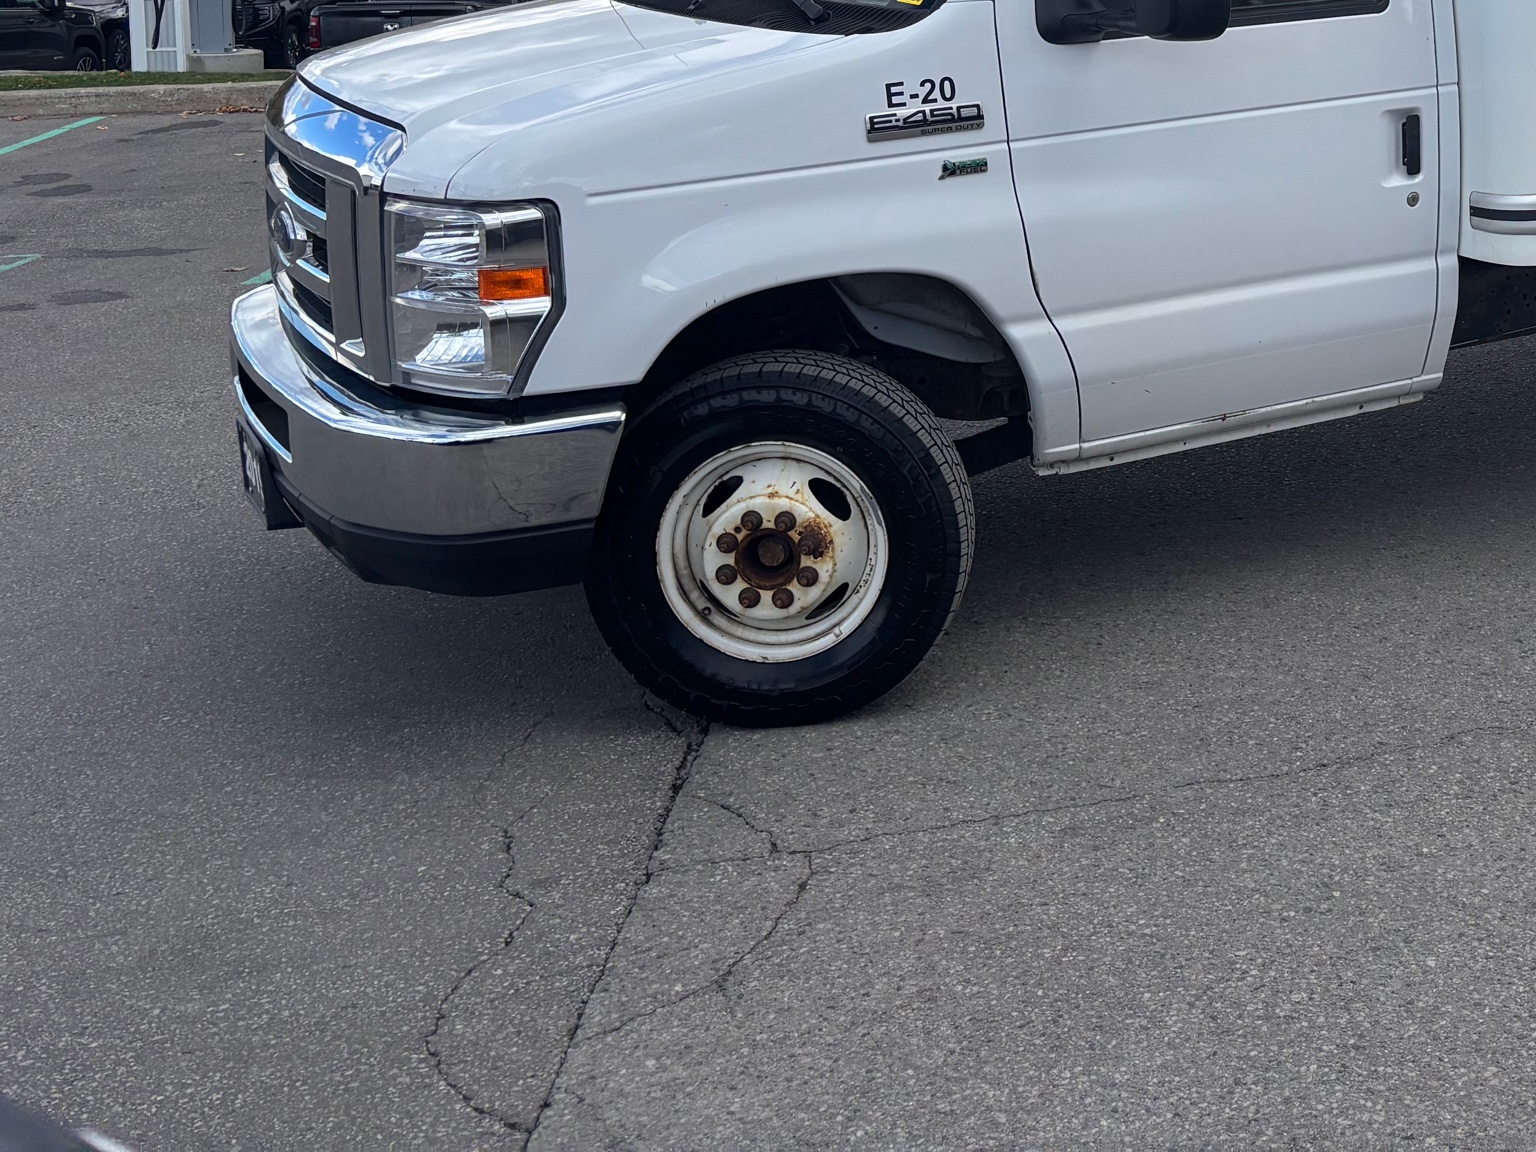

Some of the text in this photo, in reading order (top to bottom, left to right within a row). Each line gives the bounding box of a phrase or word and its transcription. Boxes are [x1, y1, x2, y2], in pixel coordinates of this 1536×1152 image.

[885, 76, 956, 108] E-20
[868, 104, 983, 133] E-450
[920, 122, 983, 135] SUPER DUTY
[956, 159, 986, 168] FLEX
[959, 166, 986, 175] FUEL
